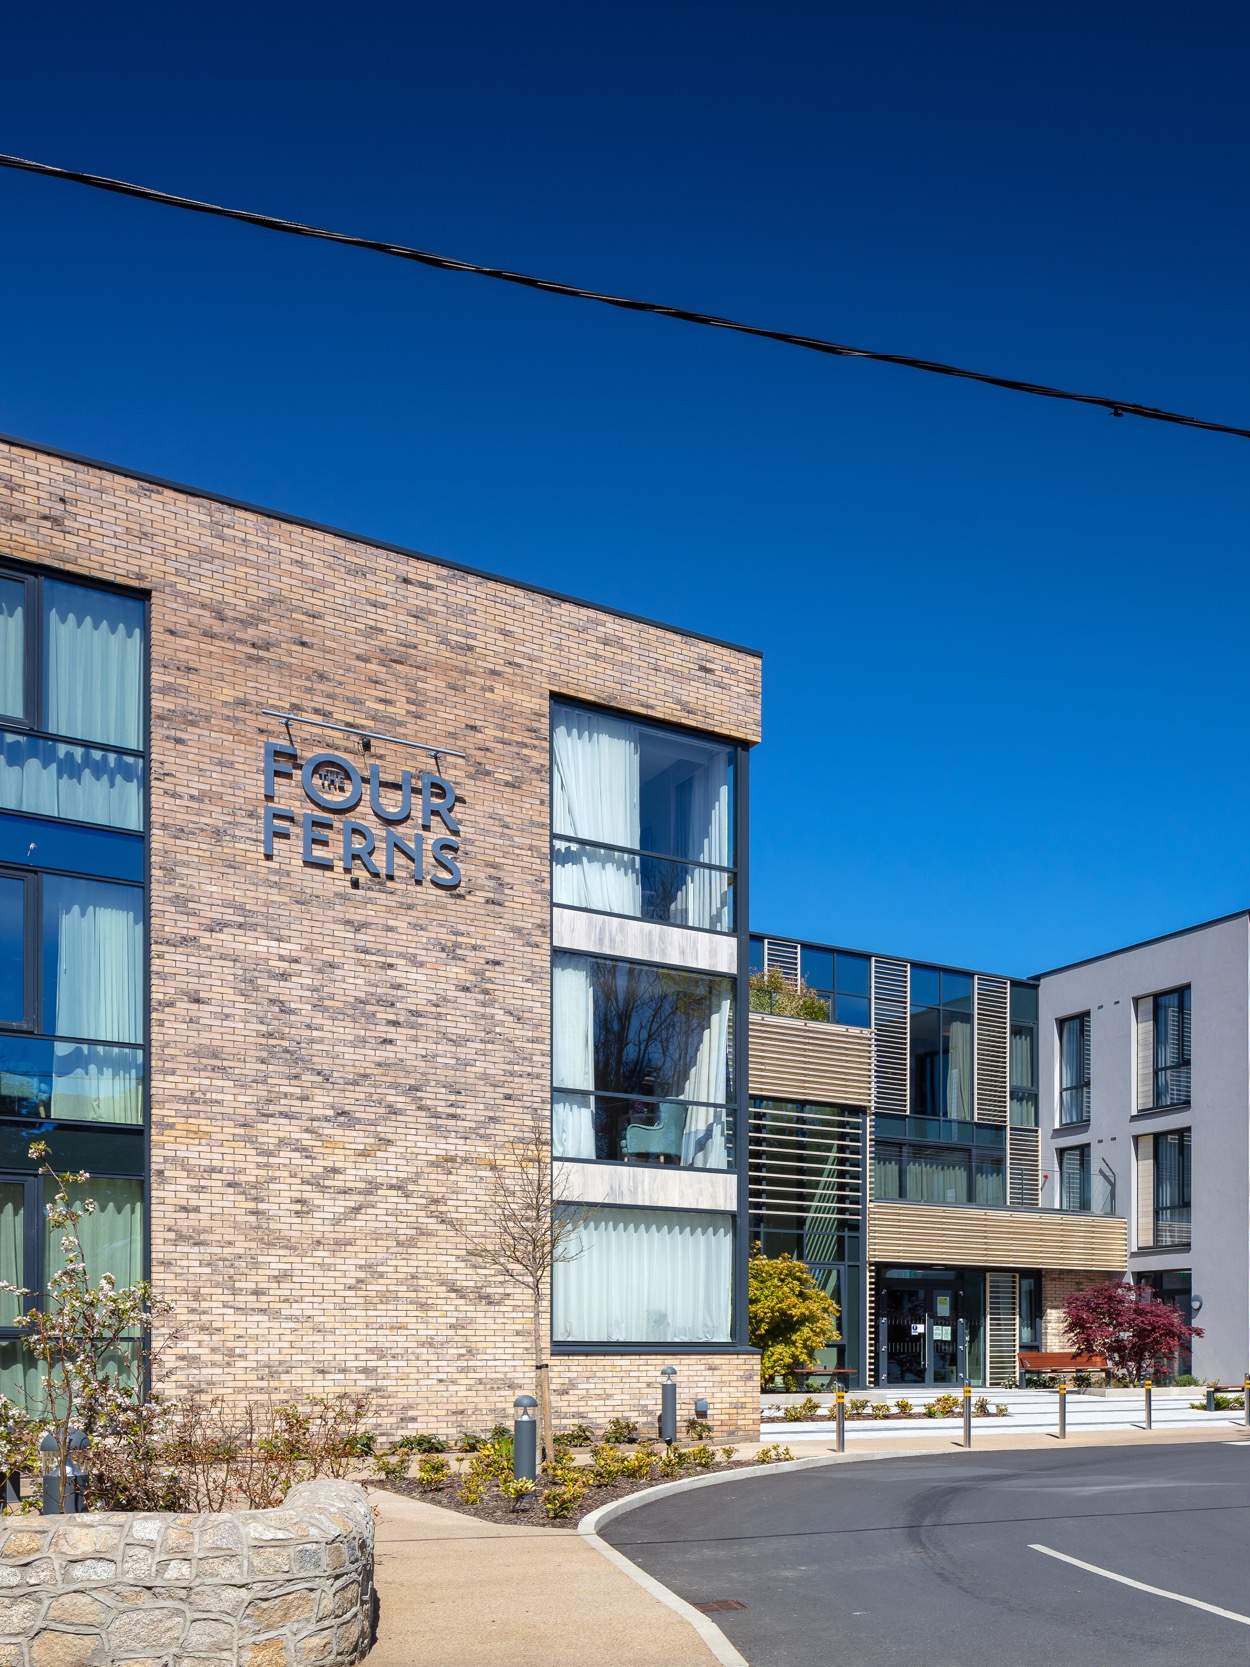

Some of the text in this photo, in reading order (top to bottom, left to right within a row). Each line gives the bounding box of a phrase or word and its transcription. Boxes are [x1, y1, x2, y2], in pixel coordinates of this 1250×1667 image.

[263, 740, 460, 833] FOUR
[318, 769, 345, 787] THE
[263, 805, 461, 887] FERNS
